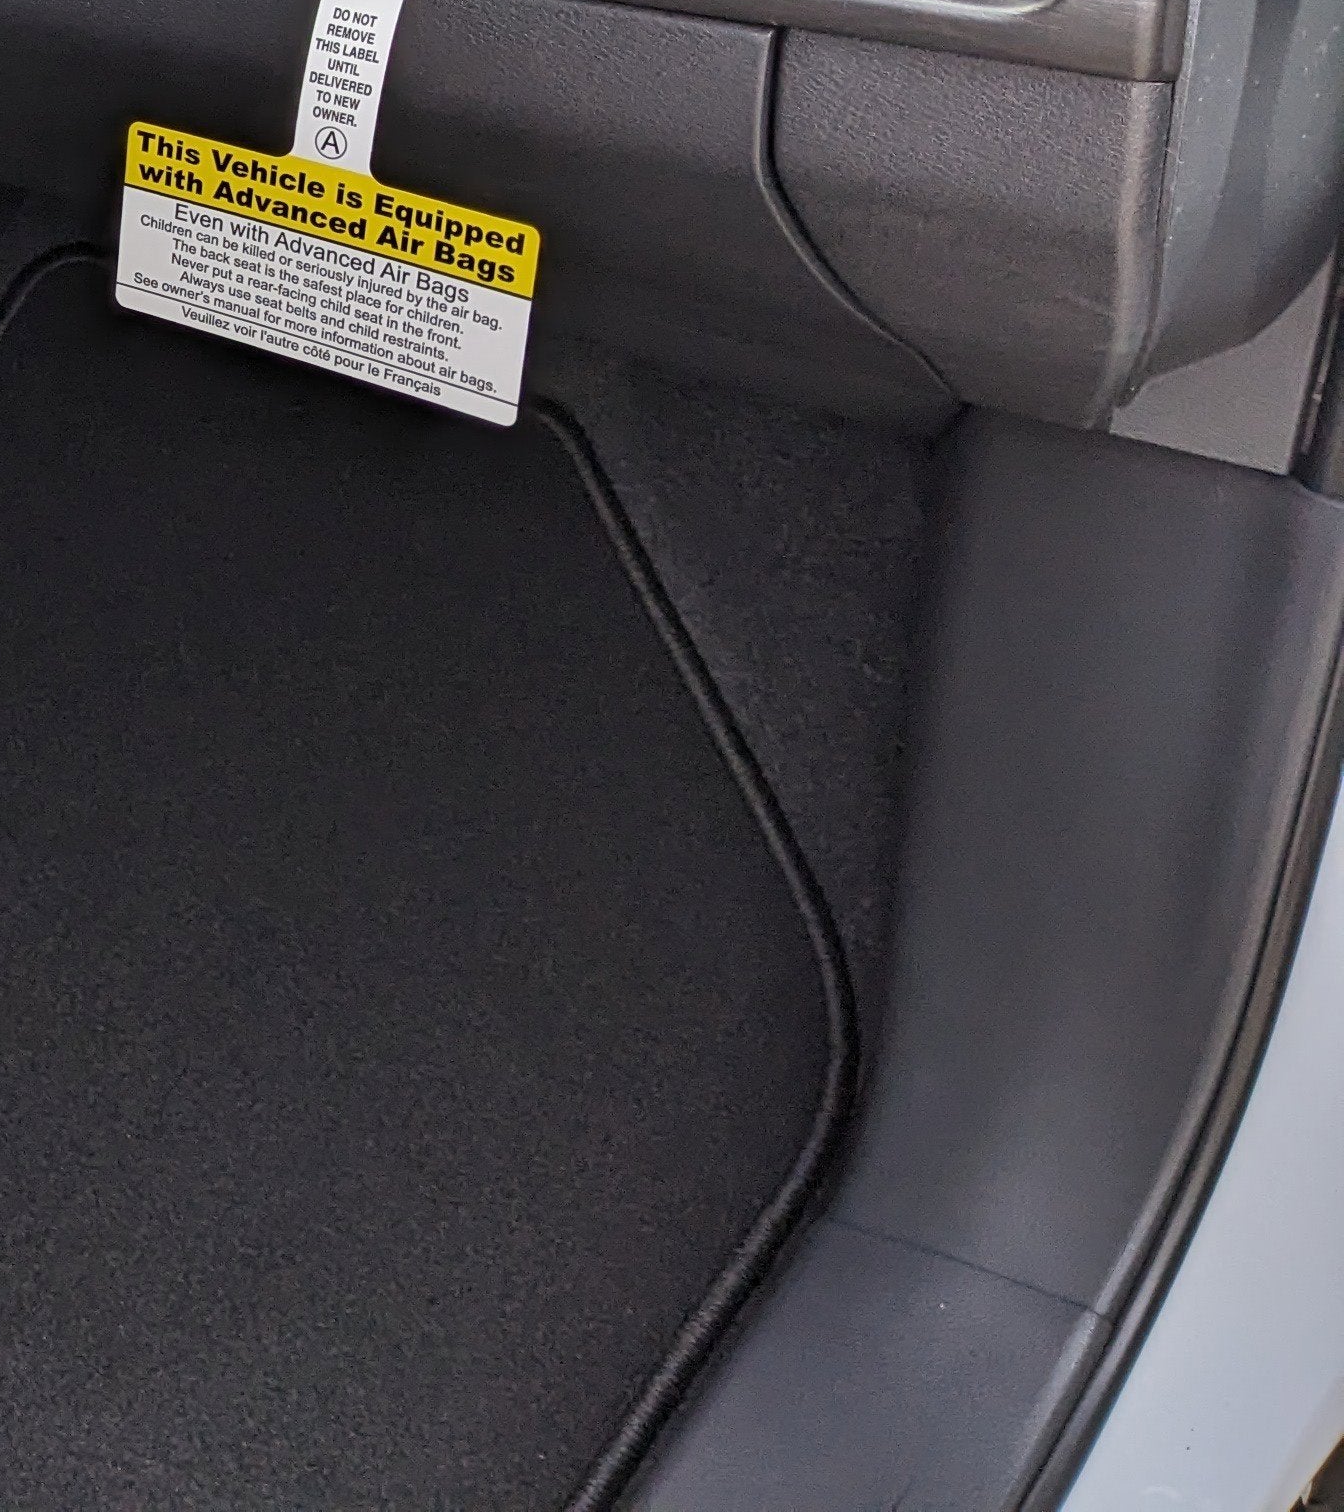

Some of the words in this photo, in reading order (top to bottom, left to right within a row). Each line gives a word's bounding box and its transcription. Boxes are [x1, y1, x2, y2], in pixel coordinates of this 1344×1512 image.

[315, 38, 340, 54] THIS
[342, 44, 380, 64] LABEL
[326, 23, 376, 45] REMOVE
[333, 7, 350, 22] DO
[352, 11, 378, 28] NOT
[309, 71, 373, 97] DELIVERED
[316, 90, 331, 103] TO
[333, 94, 361, 111] NEW
[327, 58, 360, 77] UNTIL
[312, 106, 358, 127] OWNER.
[320, 130, 340, 155] A
[137, 129, 201, 165] This
[211, 149, 325, 199] Vehicle
[335, 183, 363, 210] is
[373, 193, 526, 256] Equipped
[138, 163, 204, 195] with
[212, 180, 367, 241] Advanced
[375, 225, 425, 256] Air
[434, 240, 516, 284] Bags
[140, 213, 193, 239] Children
[195, 232, 219, 246] can
[222, 235, 239, 251] be
[242, 242, 275, 262] killed
[278, 255, 293, 267] or
[295, 259, 354, 287] seriously
[357, 276, 402, 300] injured
[406, 290, 423, 307] by
[426, 297, 448, 313] the
[451, 304, 471, 320] air
[472, 310, 503, 331] bag.
[172, 237, 197, 255] The
[200, 243, 231, 266] back
[233, 255, 262, 274] seat
[264, 264, 275, 278] is
[279, 268, 300, 285] the
[302, 277, 343, 298] safest
[345, 289, 382, 309] place
[385, 300, 404, 316] for
[406, 307, 464, 335] children.
[174, 202, 223, 232] Even
[230, 221, 269, 245] with
[273, 231, 375, 276] Advanced
[380, 262, 411, 285] Air
[416, 271, 470, 304] Bags
[133, 271, 159, 289] See
[162, 282, 211, 305] owner's
[213, 296, 260, 319] manual
[263, 310, 282, 326] for
[284, 317, 318, 337] more
[320, 327, 394, 361] information
[397, 353, 436, 376] about
[438, 365, 458, 381] air
[460, 370, 498, 394] bags.
[171, 253, 210, 273] Never
[212, 266, 233, 283] put
[235, 273, 244, 284] a
[247, 276, 316, 308] rear-facing
[320, 297, 351, 316] child
[353, 308, 383, 325] seat
[386, 316, 399, 330] in
[402, 321, 424, 338] the
[427, 327, 462, 349] front.
[179, 271, 225, 294] Always
[228, 287, 252, 301] use
[254, 293, 283, 310] seat
[285, 301, 317, 321] belts
[320, 313, 345, 330] and
[348, 321, 379, 340] child
[382, 331, 449, 361] restraints.
[181, 305, 231, 331] Veuillez
[233, 322, 258, 338] voir
[260, 329, 300, 352] l'autre
[302, 345, 331, 362] côté
[333, 354, 365, 372] pour
[367, 363, 380, 377] le
[383, 368, 442, 397] Français
